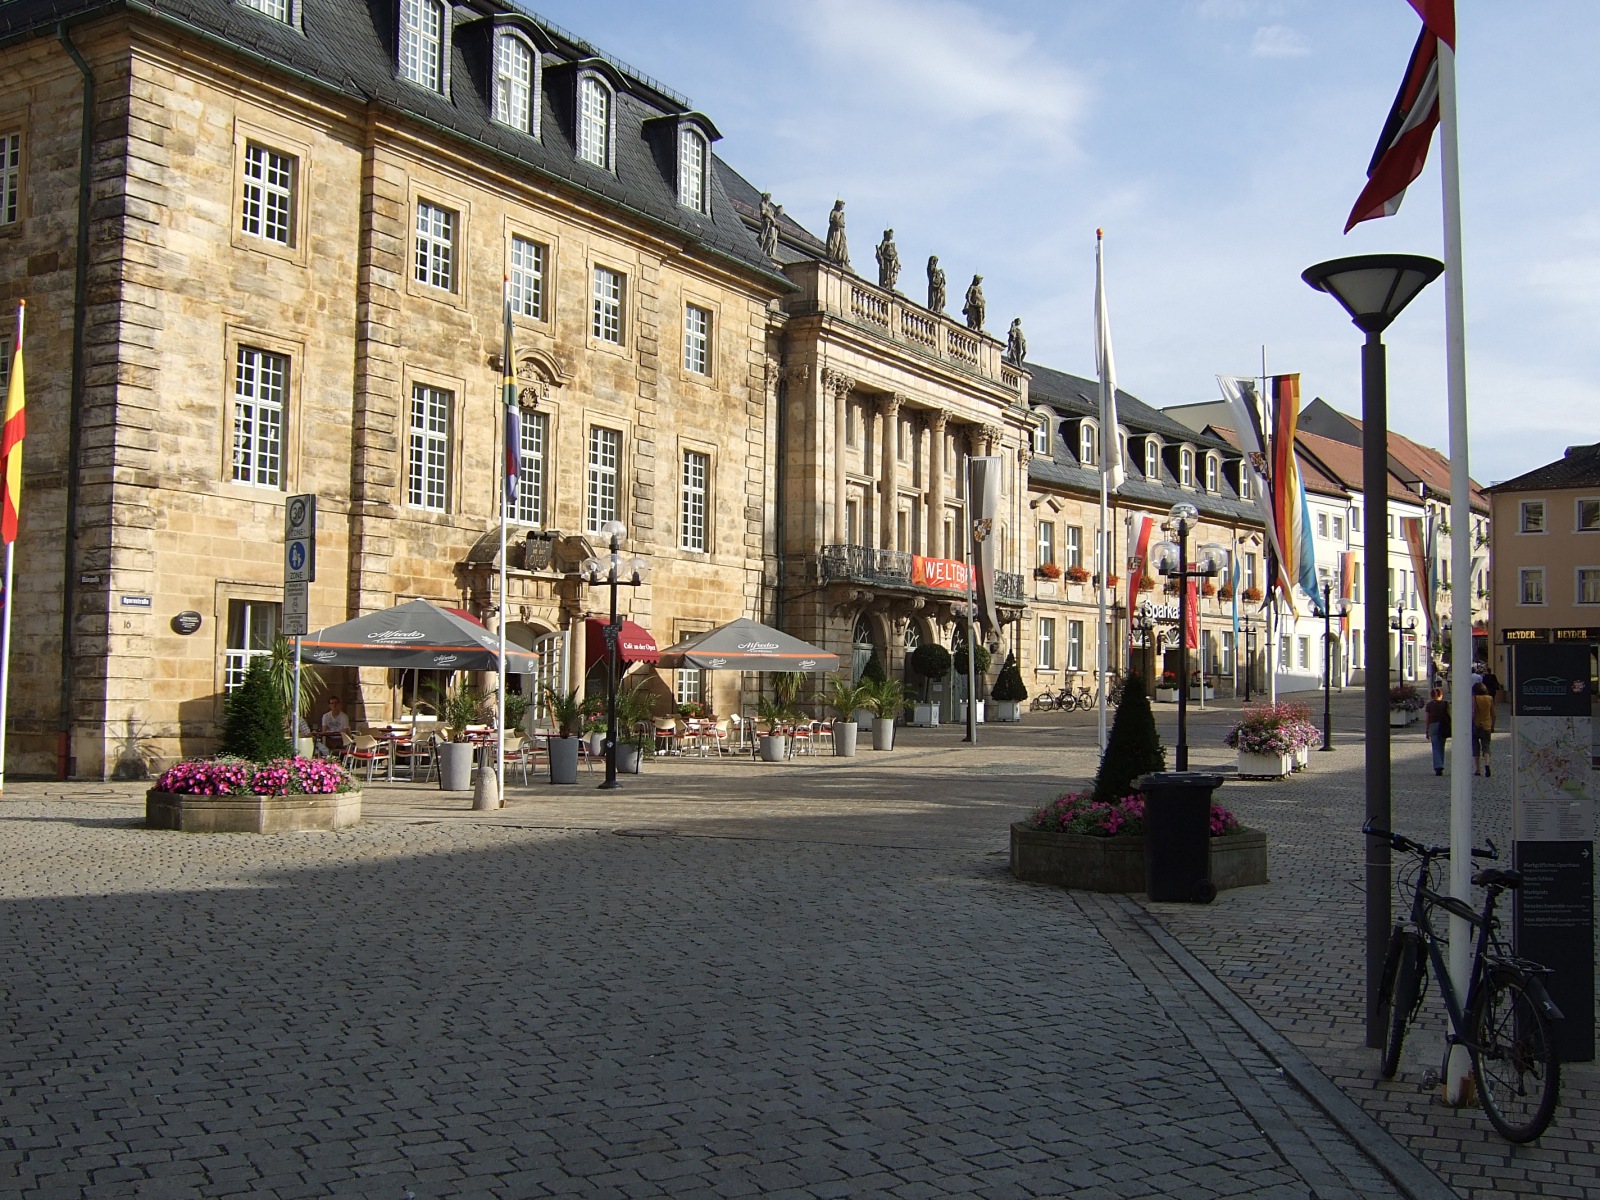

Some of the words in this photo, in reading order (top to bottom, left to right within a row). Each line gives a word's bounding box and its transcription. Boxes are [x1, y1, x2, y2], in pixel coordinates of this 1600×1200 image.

[292, 506, 303, 520] 30
[290, 529, 304, 537] ZONE
[529, 554, 547, 566] OPER
[289, 571, 303, 580] ZONE
[1145, 600, 1180, 620] Sparka
[123, 620, 132, 629] 16
[367, 630, 425, 641] Alfredo
[1507, 630, 1536, 639] HEYDER
[1557, 629, 1587, 639] HEYDER
[645, 644, 656, 652] Oper
[737, 641, 779, 652] Alfredo
[1522, 685, 1567, 693] BAYREUTH
